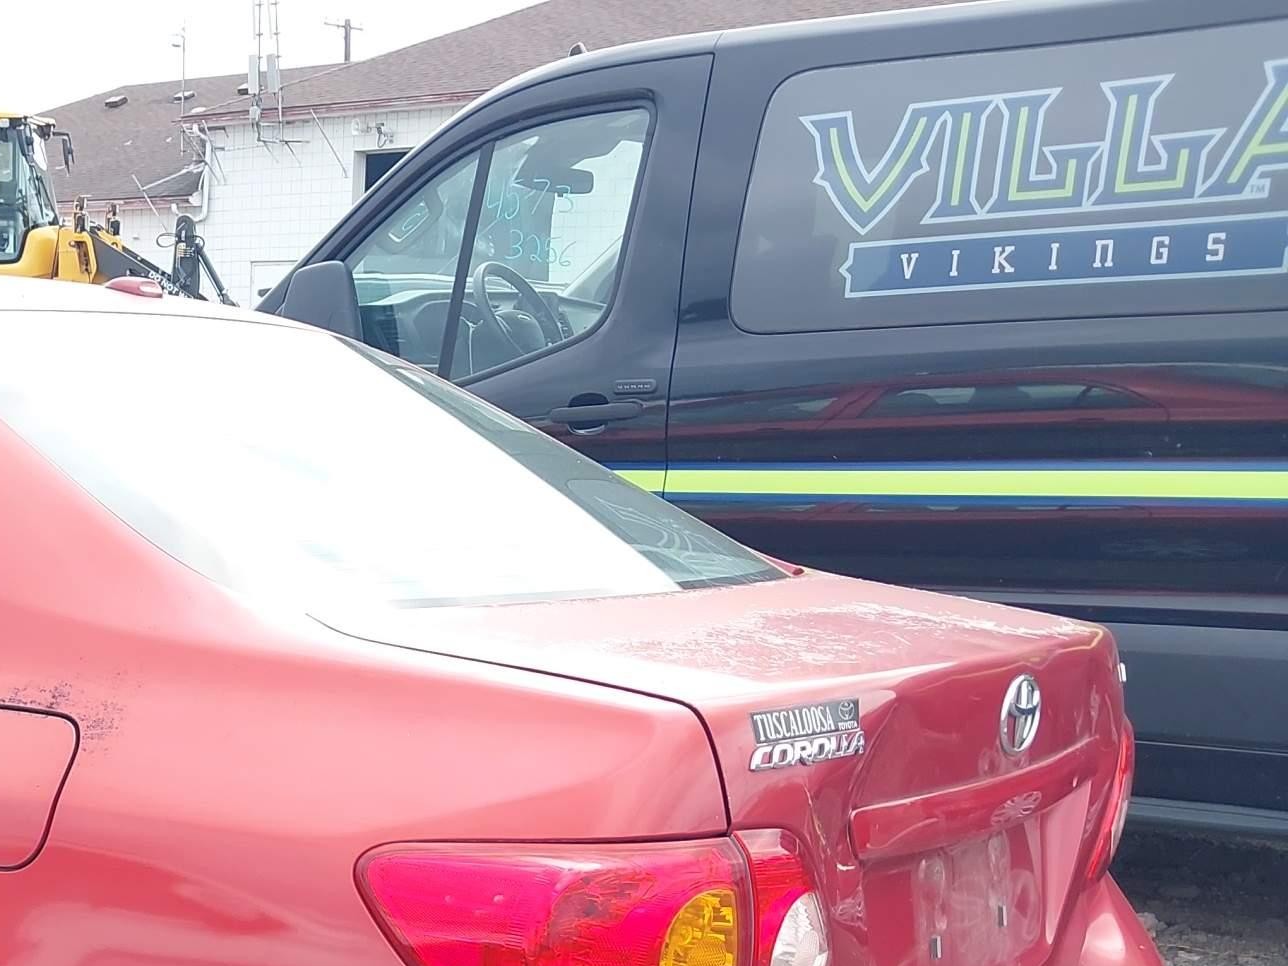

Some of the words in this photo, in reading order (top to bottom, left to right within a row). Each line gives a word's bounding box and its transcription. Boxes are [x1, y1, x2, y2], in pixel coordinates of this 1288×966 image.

[505, 229, 577, 268] 3256
[899, 231, 1227, 281] VIKINGS
[160, 278, 180, 295] NOT
[753, 705, 836, 741] TUSCALOOSA
[838, 720, 858, 731] TOYOTA
[749, 731, 865, 772] COROLLA
